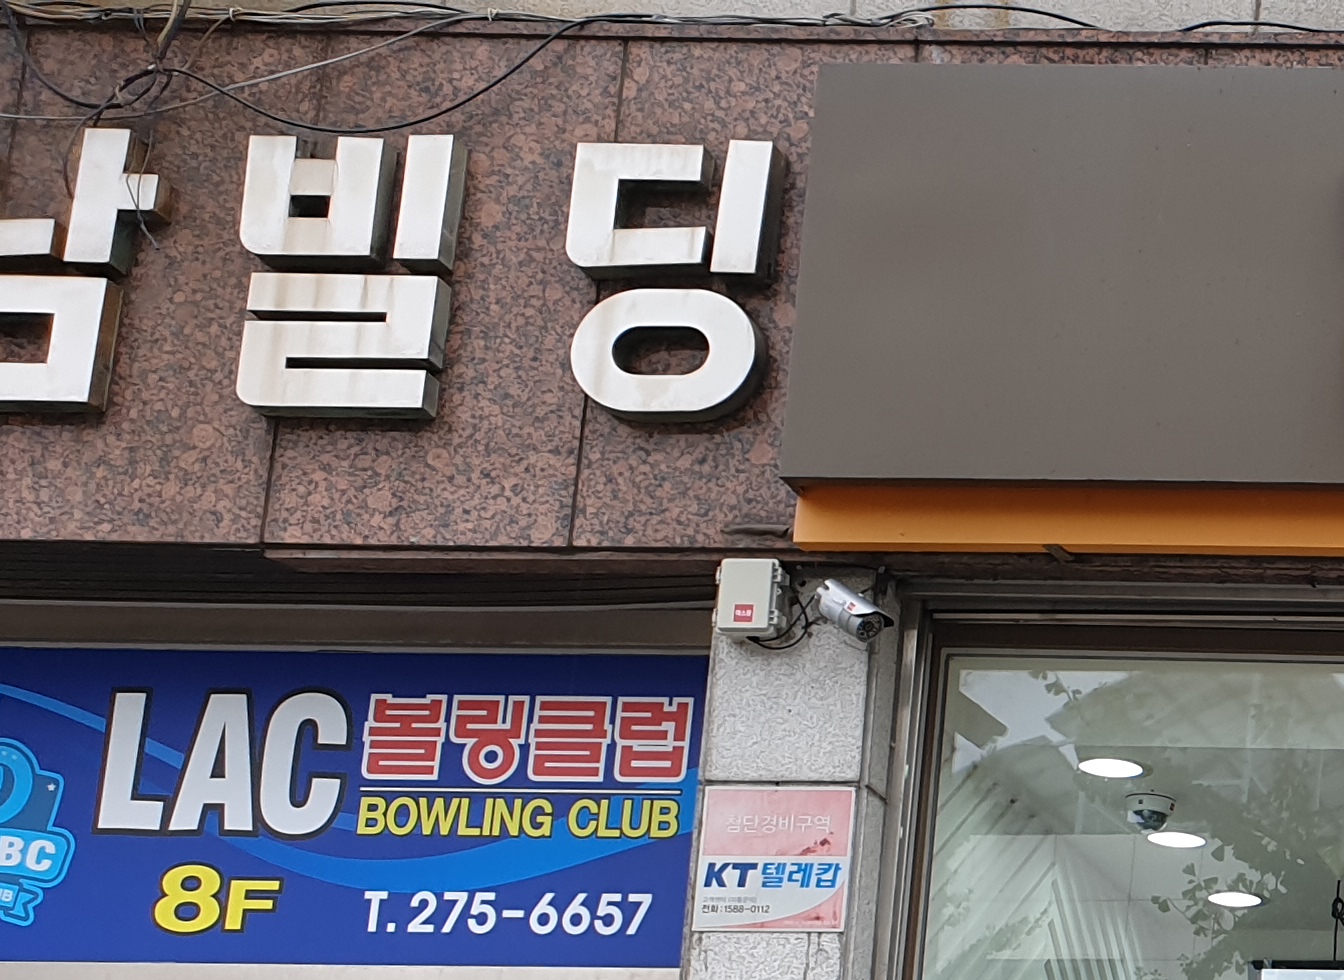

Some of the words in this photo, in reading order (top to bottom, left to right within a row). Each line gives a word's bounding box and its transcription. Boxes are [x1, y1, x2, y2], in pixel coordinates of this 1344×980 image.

[93, 686, 352, 841] LAC
[361, 693, 695, 785] 볼링클럽
[356, 794, 554, 839] BOWLING
[566, 795, 681, 839] CLUB
[725, 814, 832, 834] 첨단경비구역
[152, 863, 285, 936] 8F
[703, 861, 759, 889] KT
[761, 861, 842, 889] 텔레캅
